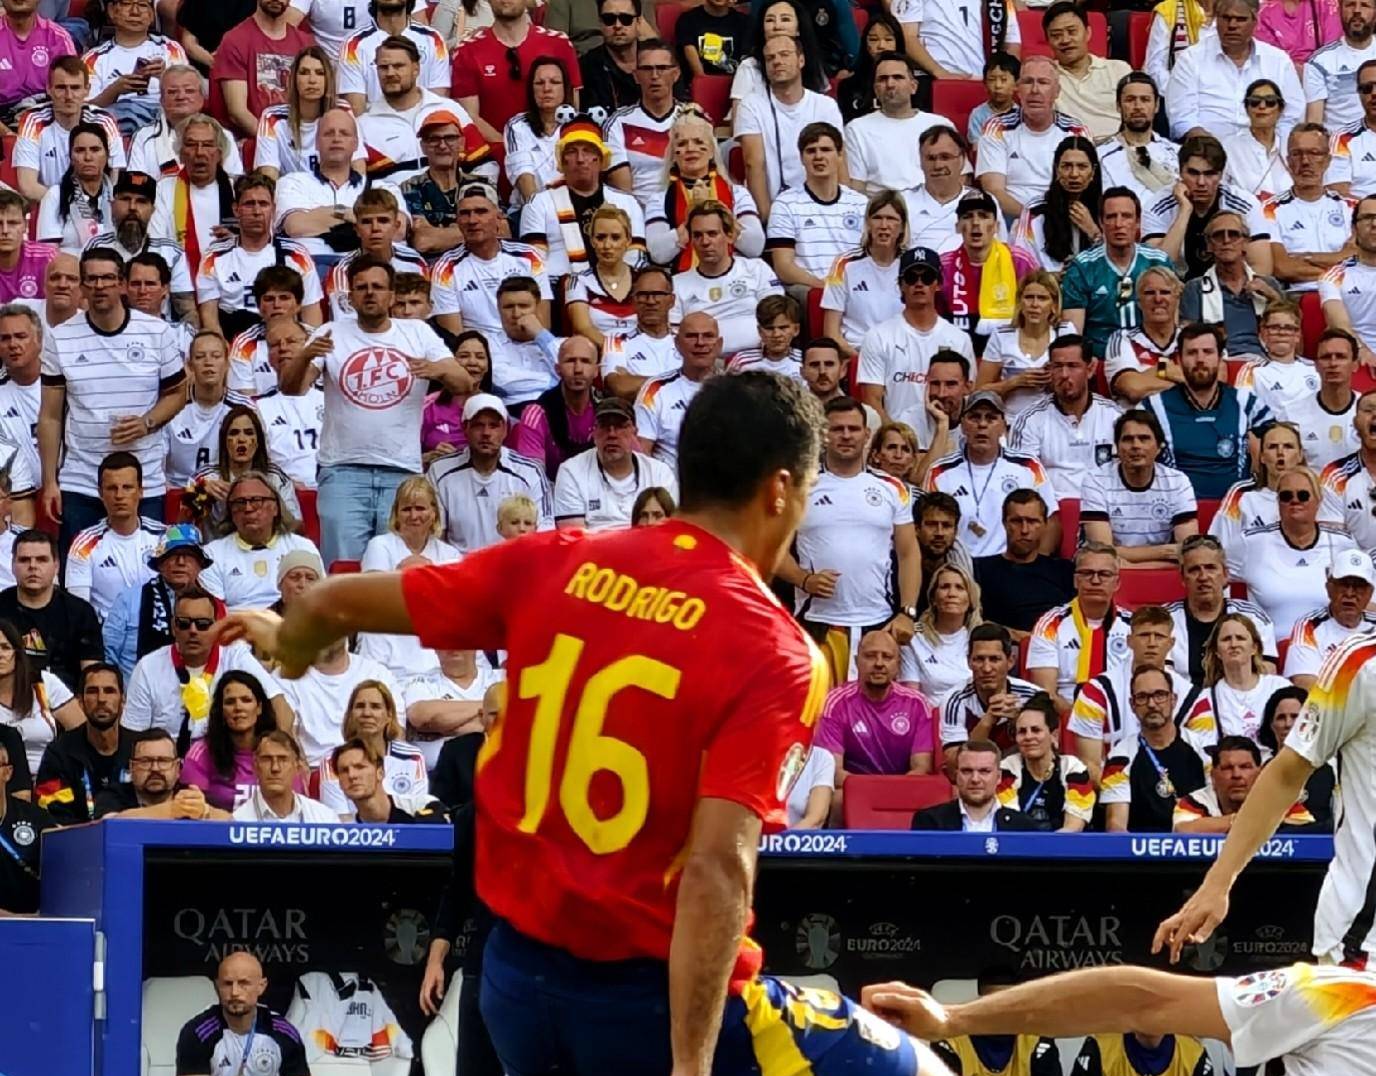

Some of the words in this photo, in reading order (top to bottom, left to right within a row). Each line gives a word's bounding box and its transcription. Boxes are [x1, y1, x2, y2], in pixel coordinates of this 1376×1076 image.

[344, 7, 356, 29] 8
[958, 6, 969, 28] 1
[294, 428, 317, 450] 17
[564, 562, 706, 630] RODRIGO
[518, 633, 682, 854] 16
[173, 908, 308, 946] QATAR
[990, 915, 1122, 952] QATAR
[1020, 949, 1124, 969] AIRWAYS
